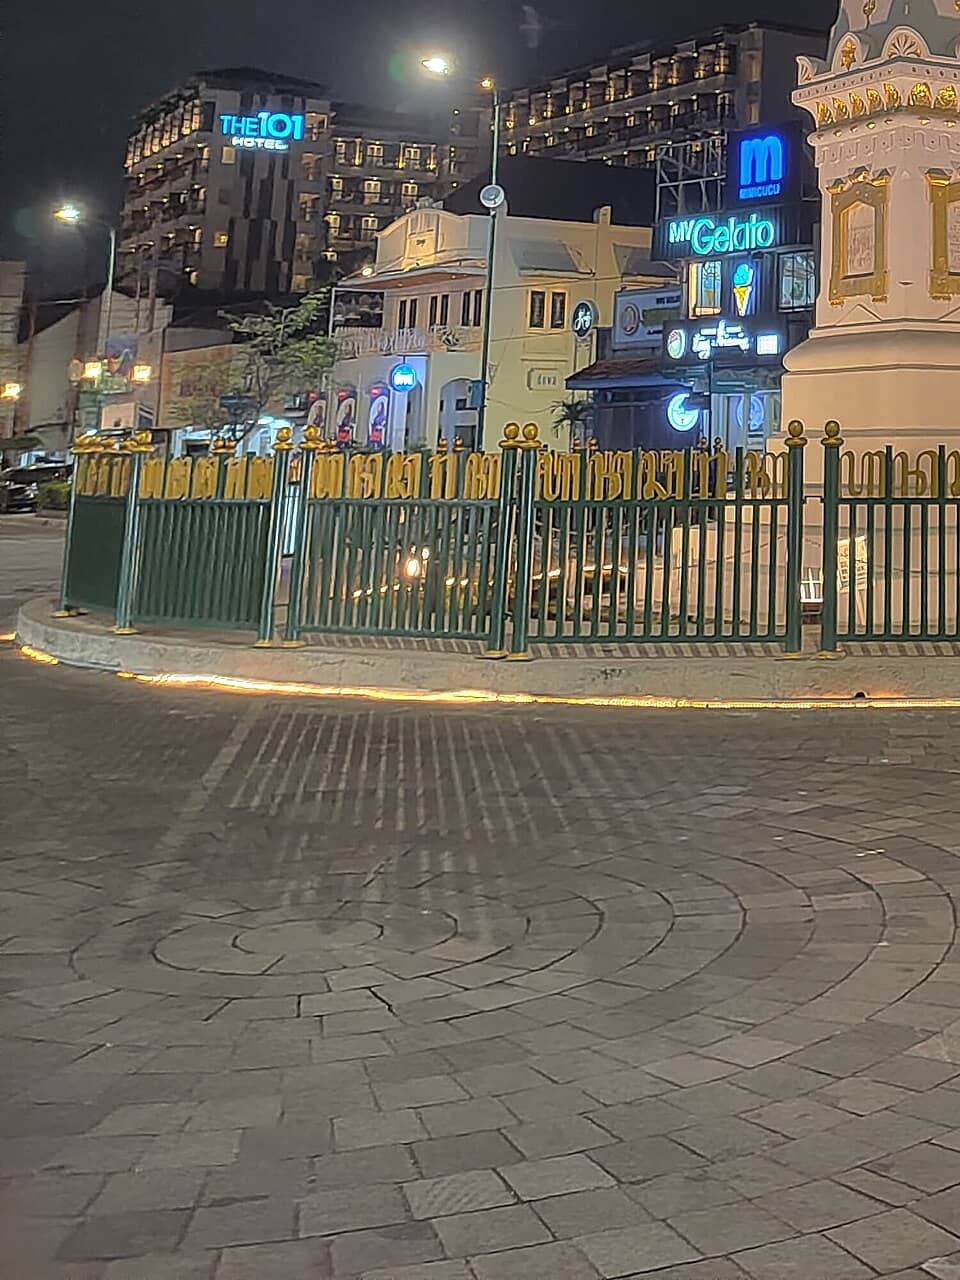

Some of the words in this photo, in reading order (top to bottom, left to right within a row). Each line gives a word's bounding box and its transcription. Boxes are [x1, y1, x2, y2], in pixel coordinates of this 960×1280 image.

[219, 115, 258, 136] THE
[257, 111, 304, 140] 101
[231, 136, 288, 150] HOTEL
[690, 214, 775, 255] Gelato
